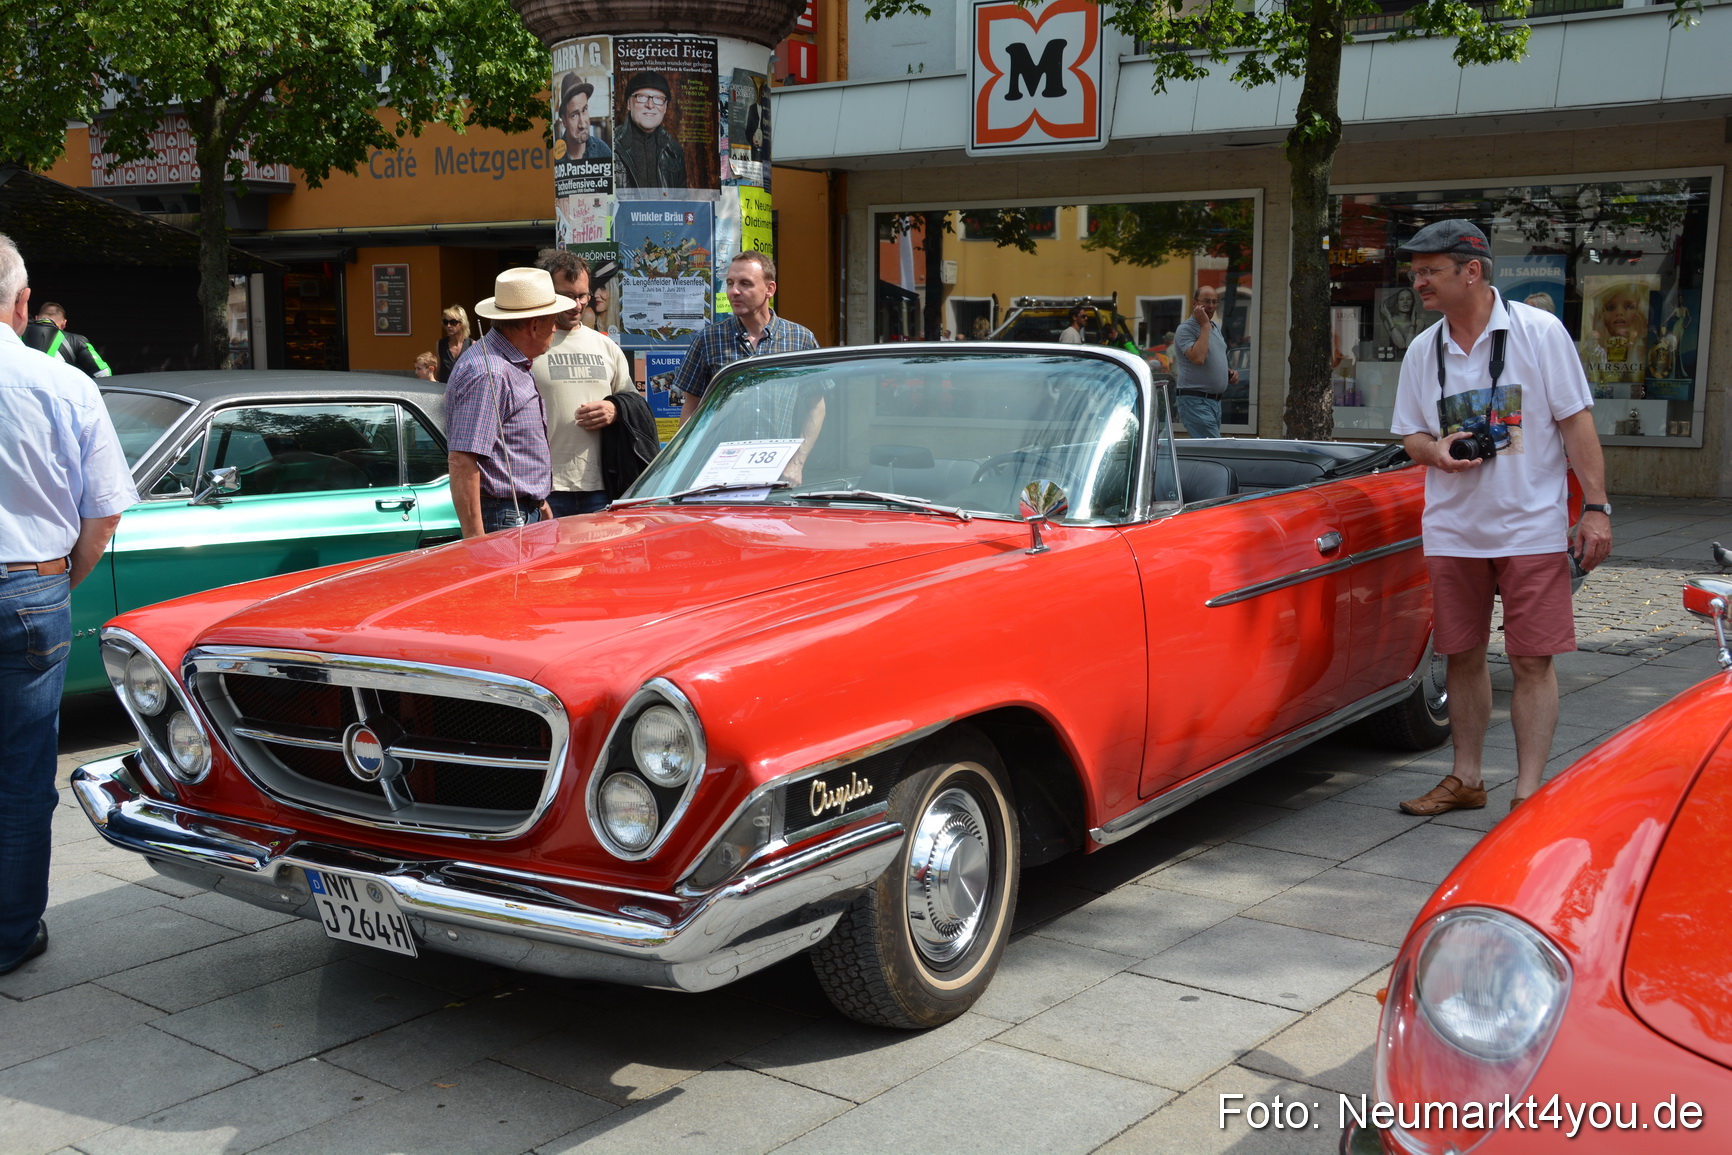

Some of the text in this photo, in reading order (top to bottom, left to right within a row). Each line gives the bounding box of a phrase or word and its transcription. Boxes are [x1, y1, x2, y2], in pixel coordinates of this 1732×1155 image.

[589, 41, 601, 67] G
[617, 44, 713, 60] Siegfried Fietz
[1004, 39, 1067, 101] M
[369, 147, 417, 180] Café
[745, 198, 753, 209] 7.
[630, 211, 684, 222] Winkler Bräu
[572, 224, 603, 244] Entlein
[585, 250, 617, 261] BÖRNER
[1500, 267, 1561, 277] JIL SANDER
[632, 278, 671, 287] Lengenfelder
[672, 278, 705, 286] Wiesenfest
[547, 353, 605, 366] AUTHENTIC
[651, 357, 681, 366] SAUBER
[568, 366, 593, 379] LINE
[1589, 363, 1645, 371] VERSACE
[747, 451, 777, 464] 138
[810, 771, 874, 817] Chrysler
[322, 872, 359, 903] NM
[341, 904, 411, 950] 264H
